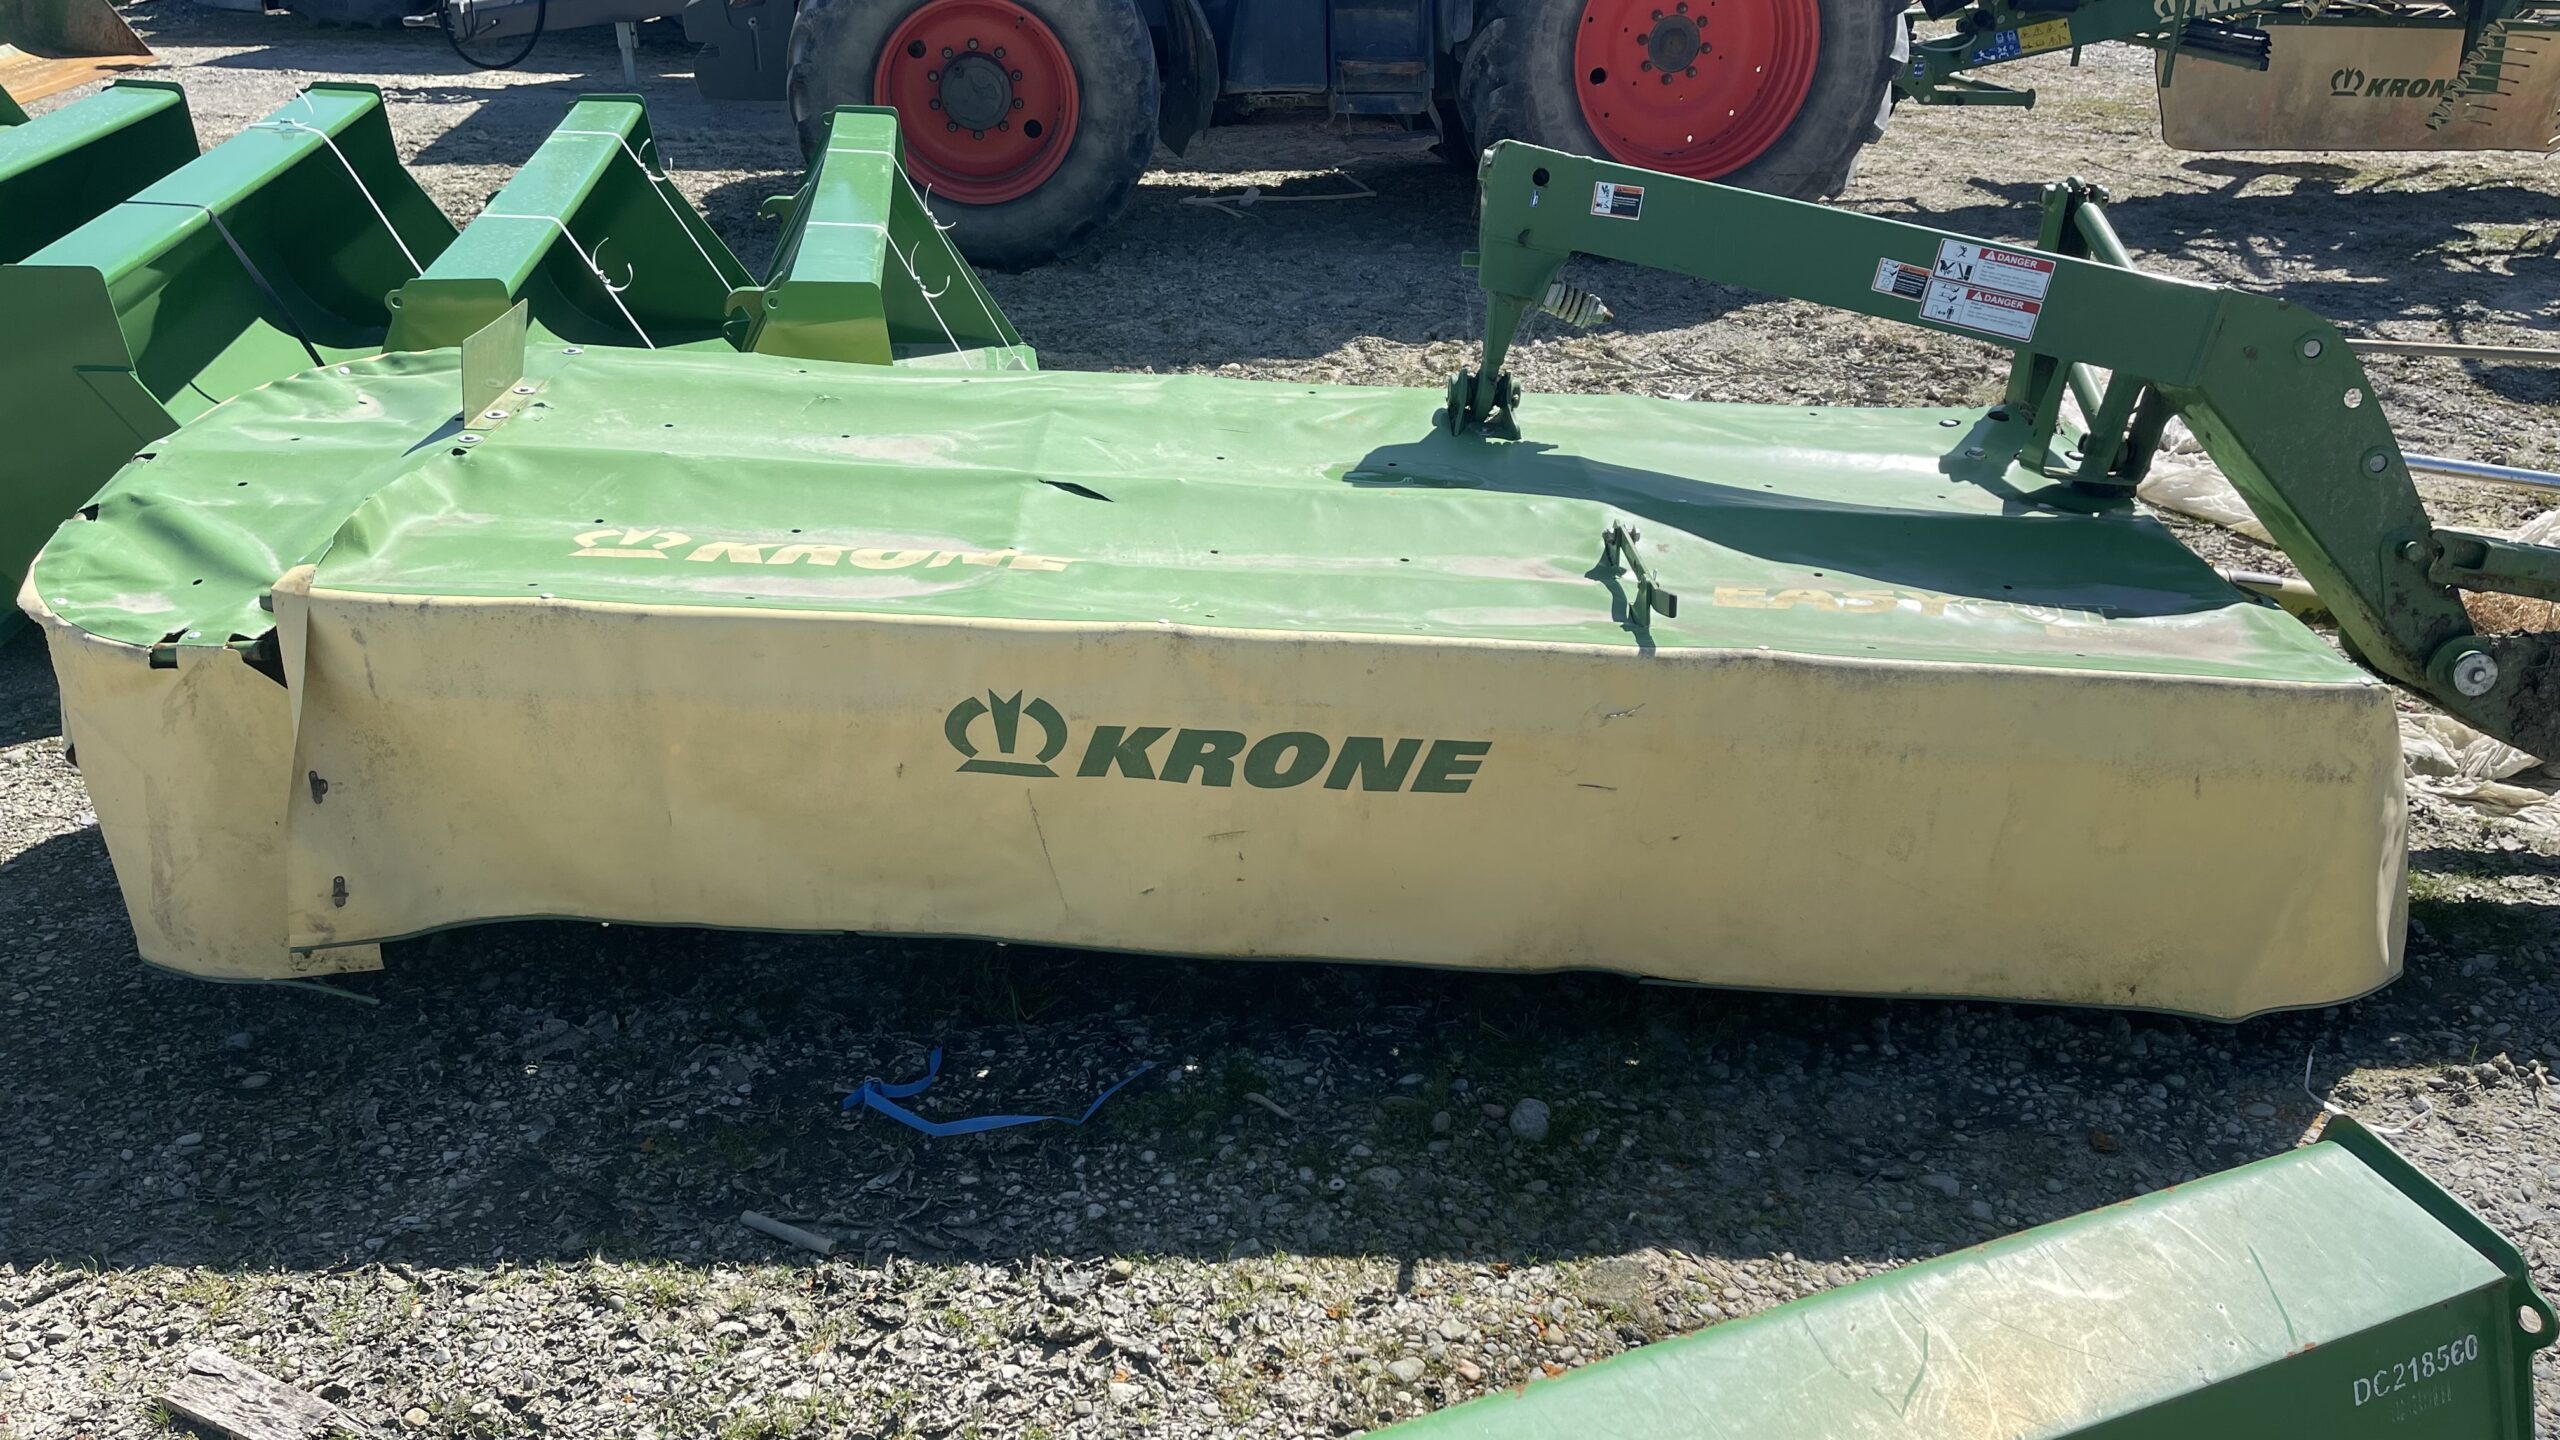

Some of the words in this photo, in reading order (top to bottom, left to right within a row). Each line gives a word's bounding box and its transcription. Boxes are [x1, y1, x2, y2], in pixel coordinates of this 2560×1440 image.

[2364, 77, 2464, 98] KRON
[1997, 254, 2038, 269] DANGER
[1984, 294, 2025, 310] DANGER
[685, 541, 1088, 572] KRONE
[1076, 725, 1492, 793] KRONE
[2353, 1334, 2478, 1406] DC218560
